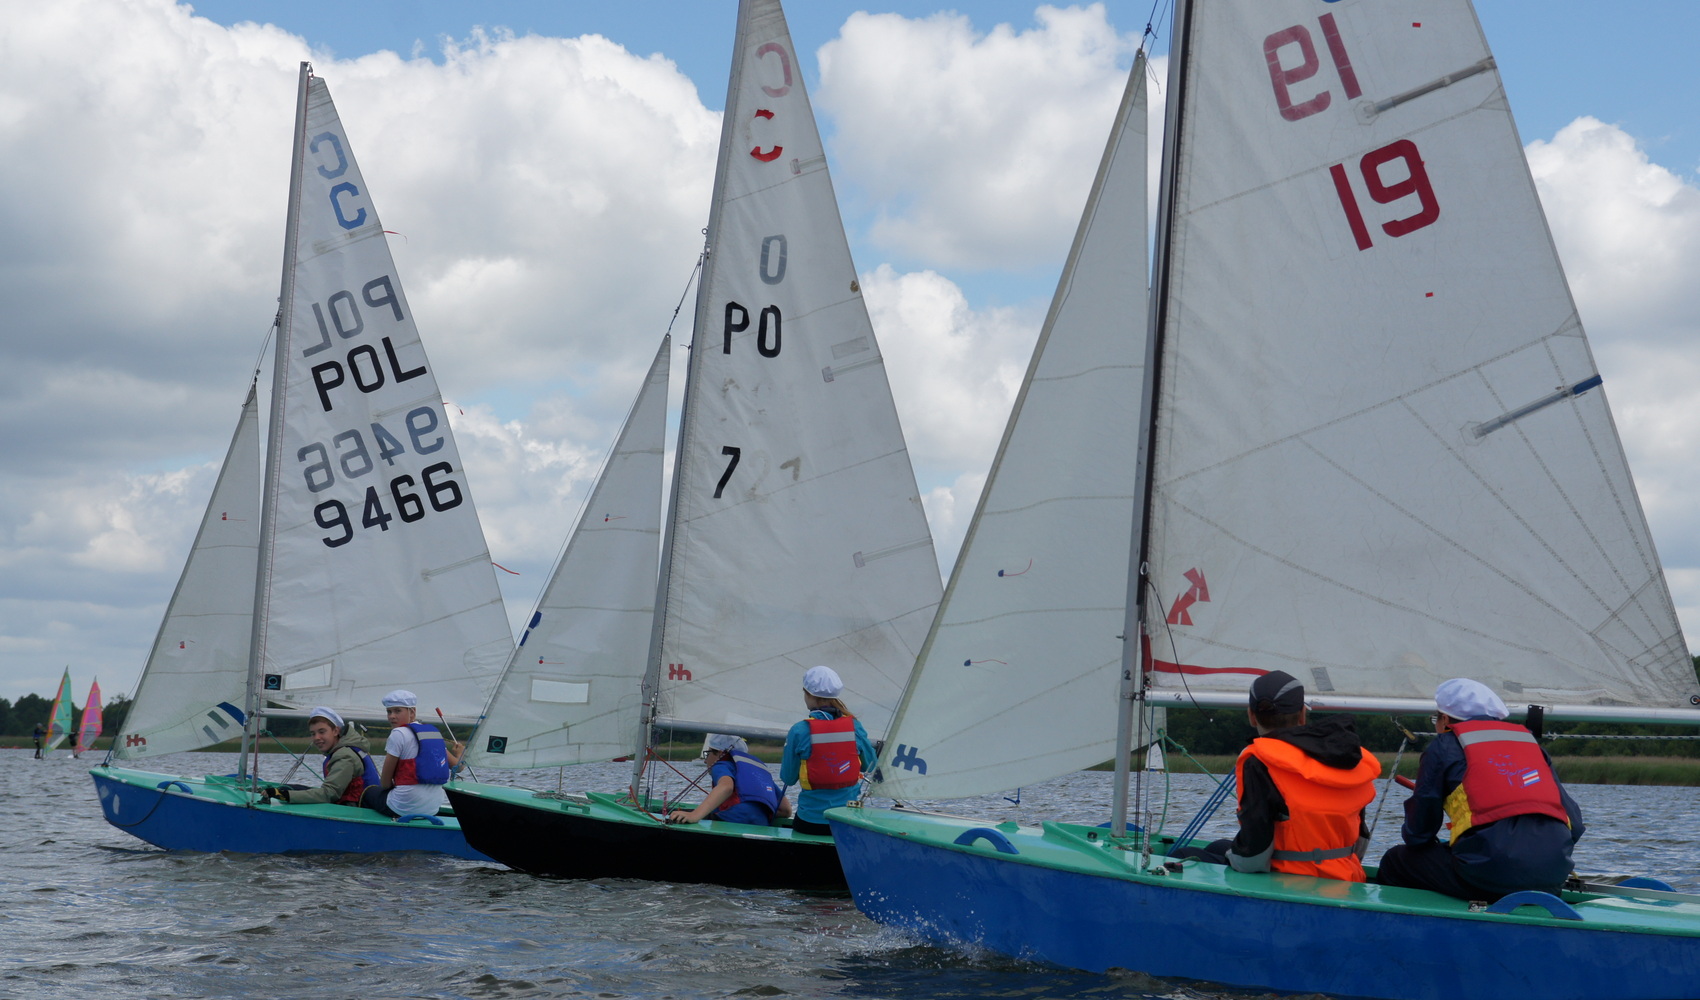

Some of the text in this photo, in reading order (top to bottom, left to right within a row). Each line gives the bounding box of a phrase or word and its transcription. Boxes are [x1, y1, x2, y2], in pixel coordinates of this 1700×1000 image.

[329, 181, 367, 230] C
[1329, 139, 1440, 251] 19
[311, 336, 428, 412] POL
[313, 461, 463, 548] 9466
